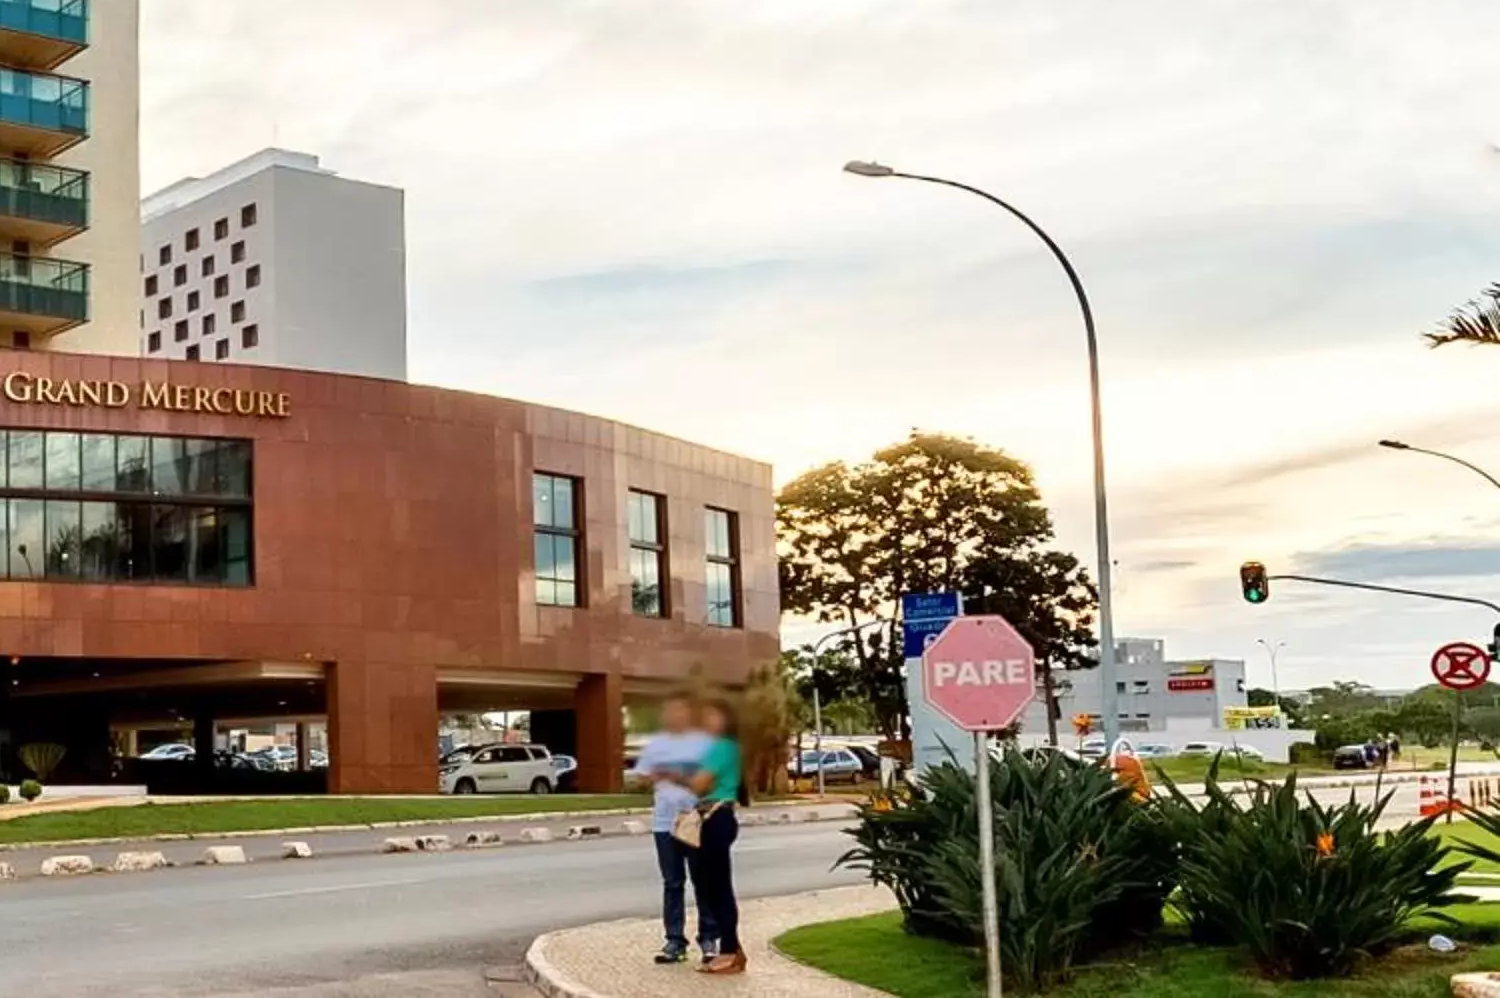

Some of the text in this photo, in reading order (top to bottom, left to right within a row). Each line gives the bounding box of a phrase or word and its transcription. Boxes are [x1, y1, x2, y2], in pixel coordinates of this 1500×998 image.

[3, 371, 293, 417] GRAND MERCURE
[933, 659, 1027, 687] PARE
